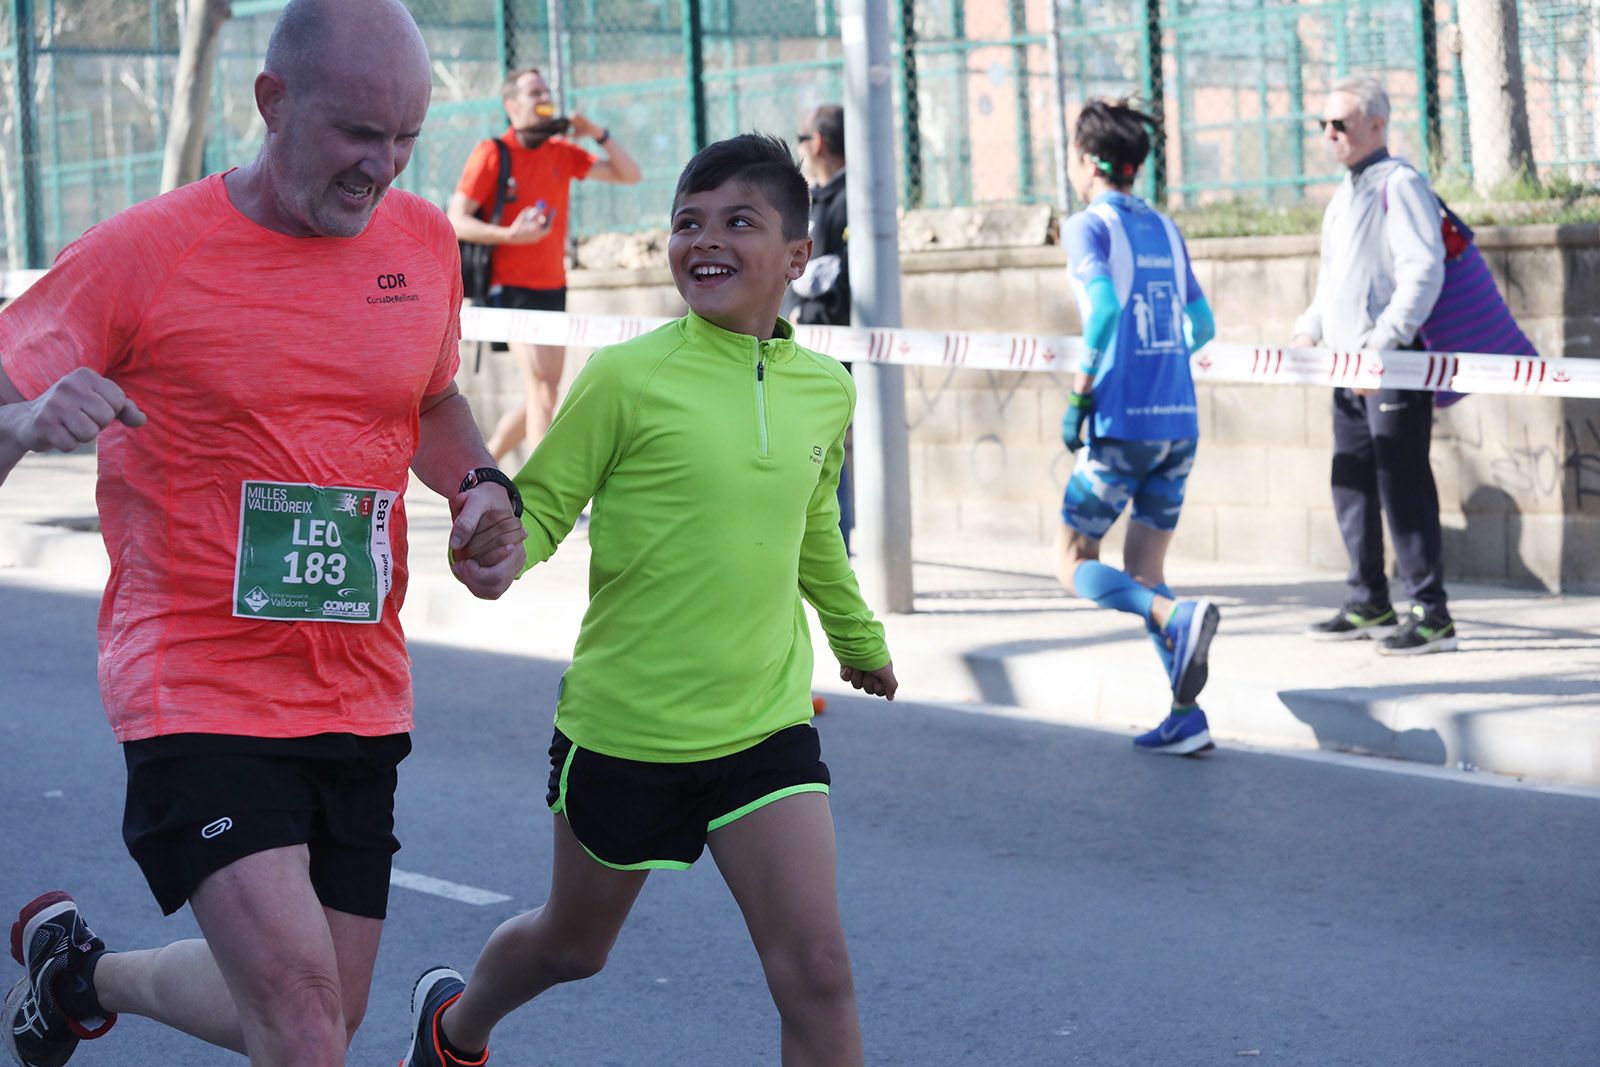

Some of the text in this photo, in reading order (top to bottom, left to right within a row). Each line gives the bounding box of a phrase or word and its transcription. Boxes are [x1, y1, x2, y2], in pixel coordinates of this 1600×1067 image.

[377, 274, 407, 289] CDR
[248, 487, 287, 499] MILLES
[248, 499, 312, 513] VALLDOREIX
[376, 499, 389, 532] 183
[293, 519, 341, 547] LEO
[283, 552, 346, 585] 183
[271, 598, 308, 607] Valldoreix
[323, 600, 370, 612] COMPLEX
